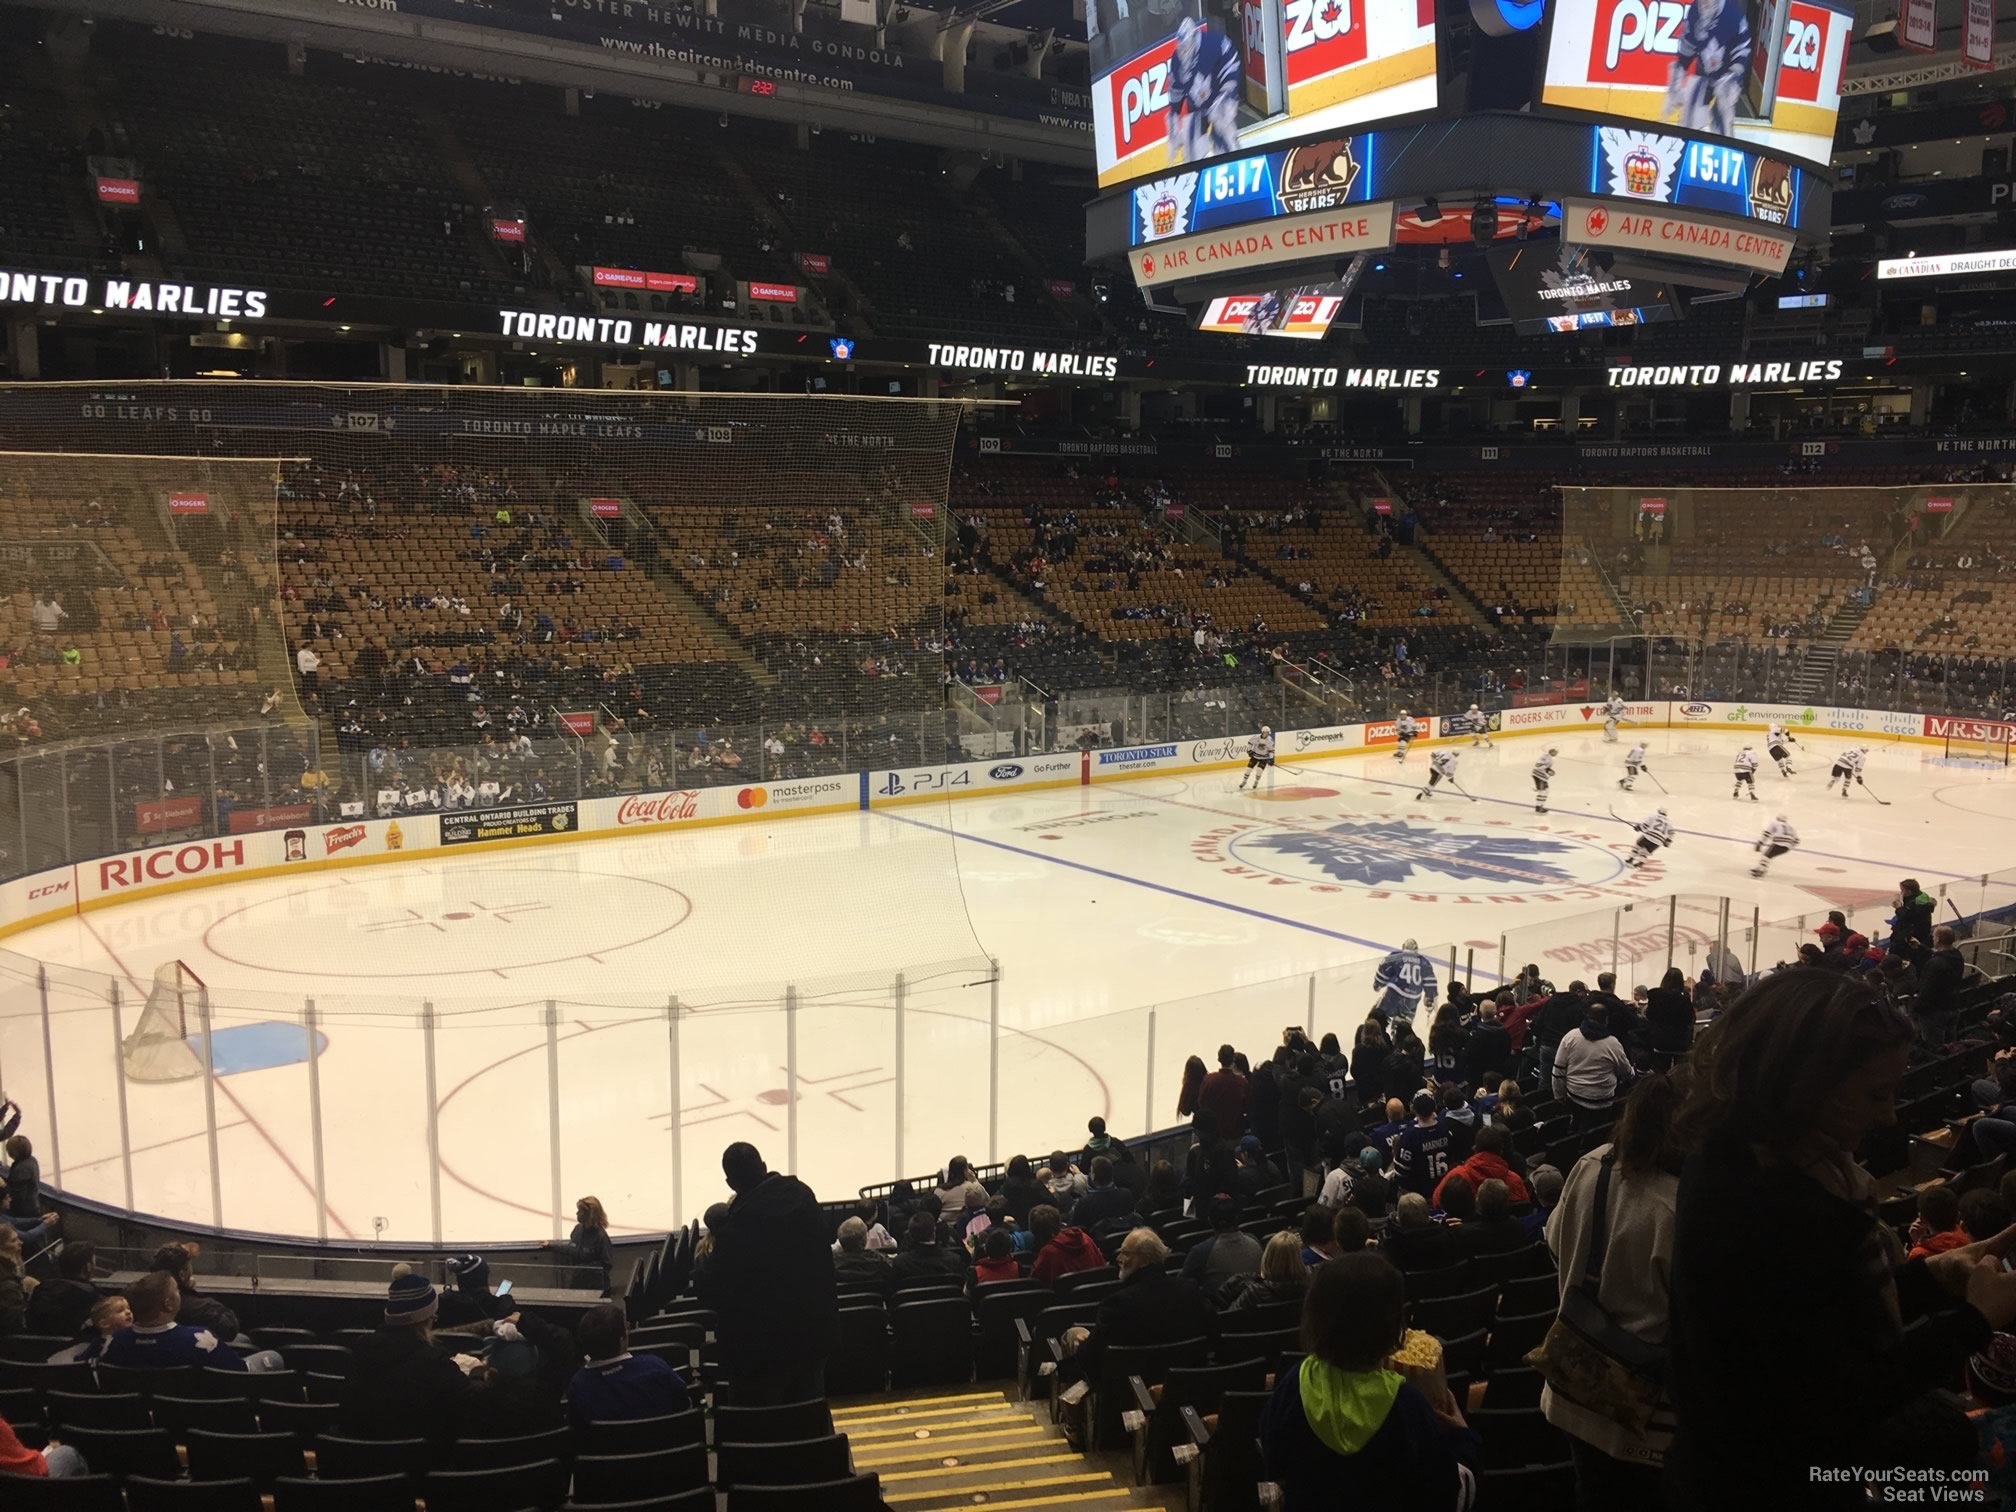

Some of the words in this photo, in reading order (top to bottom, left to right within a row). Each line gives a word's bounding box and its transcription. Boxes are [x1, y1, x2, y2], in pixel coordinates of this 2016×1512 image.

[553, 0, 633, 17] OSTER
[649, 8, 724, 34] HEWITT
[738, 25, 799, 49] MEDIA
[812, 40, 904, 68] GONDOLA
[600, 36, 854, 91] www.theaircanadacentre.com
[1690, 144, 1743, 187] 15:17
[1204, 156, 1265, 203] 15:17
[107, 187, 136, 196] ROGERS
[1163, 245, 1190, 270] AIR
[1196, 234, 1273, 263] CANADA
[1281, 219, 1370, 248] CENTRE
[1618, 216, 1653, 237] AIR
[1660, 222, 1731, 249] CANADA
[1735, 234, 1785, 260] CENTRE
[1899, 263, 1941, 276] CANADIAN
[1950, 259, 1997, 272] DRAUGHT
[1536, 287, 1583, 301] TORONTO
[1585, 279, 1632, 294] MARLIES
[104, 280, 268, 318] MARLIES
[499, 310, 632, 345] TORONTO
[643, 322, 759, 354] MARLIES
[928, 343, 1025, 371] TORONTO
[1031, 352, 1118, 377] MARLIES
[1247, 365, 1338, 386] TORONTO
[1345, 368, 1440, 388] MARLIES
[1607, 364, 1720, 387] TORONTO
[1729, 360, 1844, 384] MARLIES
[82, 405, 105, 419] GO
[118, 406, 177, 421] LEAFS
[189, 408, 212, 422] GO
[349, 415, 376, 429] 107
[463, 419, 532, 435] TORONTO
[539, 421, 587, 436] MAPLE
[599, 424, 642, 439] LEAFS
[709, 428, 730, 441] 108
[981, 439, 998, 450] 109
[1059, 442, 1088, 453] TORONTO
[1581, 447, 1618, 457] TORONTO
[1620, 446, 1658, 457] RAPTORS
[1660, 445, 1712, 457] BASKETBALL
[1803, 443, 1824, 455] 112
[1937, 440, 1950, 452] WE
[1953, 440, 1973, 452] THE
[1977, 438, 2016, 451] NORTH
[1334, 449, 1350, 458] THE
[1353, 449, 1383, 458] NORTH
[1637, 706, 1654, 715] TIRE
[1687, 704, 1707, 713] AHL
[1748, 708, 1818, 722] environmental
[1509, 711, 1542, 725] ROGERS
[1544, 711, 1554, 721] 4K
[1555, 710, 1567, 720] TV
[1830, 721, 1865, 731] CISCO
[1310, 731, 1344, 744] Greenpark
[1883, 725, 1916, 735] CISCO
[1104, 749, 1149, 763] TORONTO
[1150, 746, 1174, 758] STAR
[1192, 740, 1222, 763] Crown
[995, 766, 1018, 778] Ford
[1034, 764, 1044, 773] Go
[1045, 761, 1071, 772] Further
[1119, 759, 1157, 771] thestar.com
[772, 781, 841, 797] masterpass
[913, 770, 971, 791] PS4
[154, 807, 194, 820] Sctiabank
[444, 815, 478, 825] CENTRAL
[480, 811, 512, 821] ONTARIO
[513, 807, 547, 818] BUILDING
[547, 804, 575, 815] TRADES
[617, 790, 701, 825] Coca-Cola
[327, 828, 363, 847] French's
[478, 826, 513, 838] Hammer
[517, 823, 542, 834] Heads
[100, 839, 244, 891] RICOH
[28, 880, 70, 900] CCM
[1400, 965, 1422, 986] 40
[1422, 1137, 1449, 1150] MARNER
[1400, 1147, 1413, 1161] 16
[1427, 1152, 1449, 1179] 16
